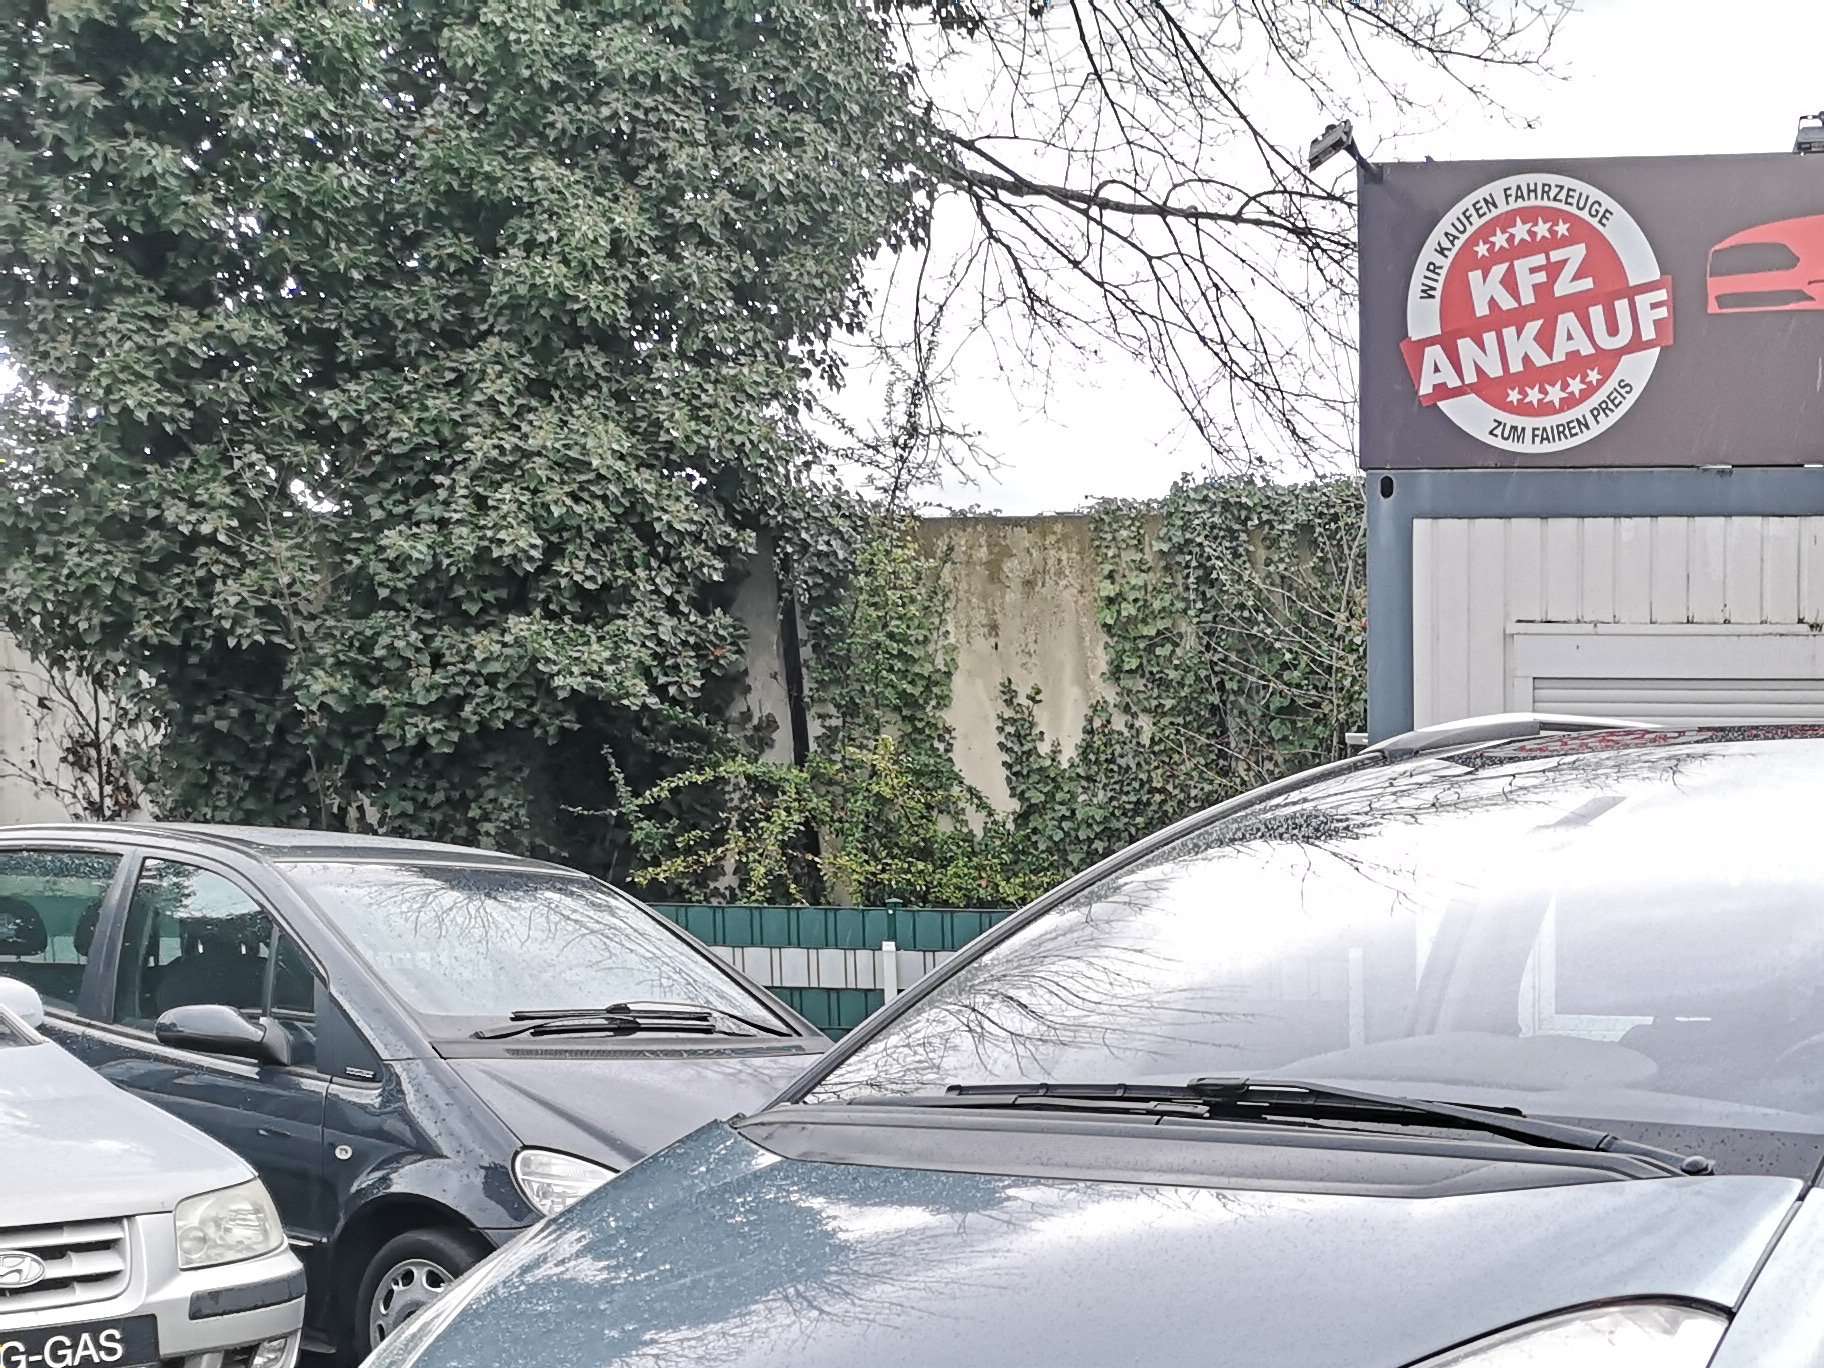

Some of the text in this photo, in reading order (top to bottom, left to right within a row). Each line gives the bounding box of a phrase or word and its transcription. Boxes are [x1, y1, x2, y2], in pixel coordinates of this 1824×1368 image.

[1419, 182, 1614, 300] WIR KAUFEN FAHRZEUGE
[1467, 242, 1594, 318] KFZ
[1418, 288, 1669, 396] ANKAUF
[1488, 378, 1634, 445] ZUM FAIREN PREIS
